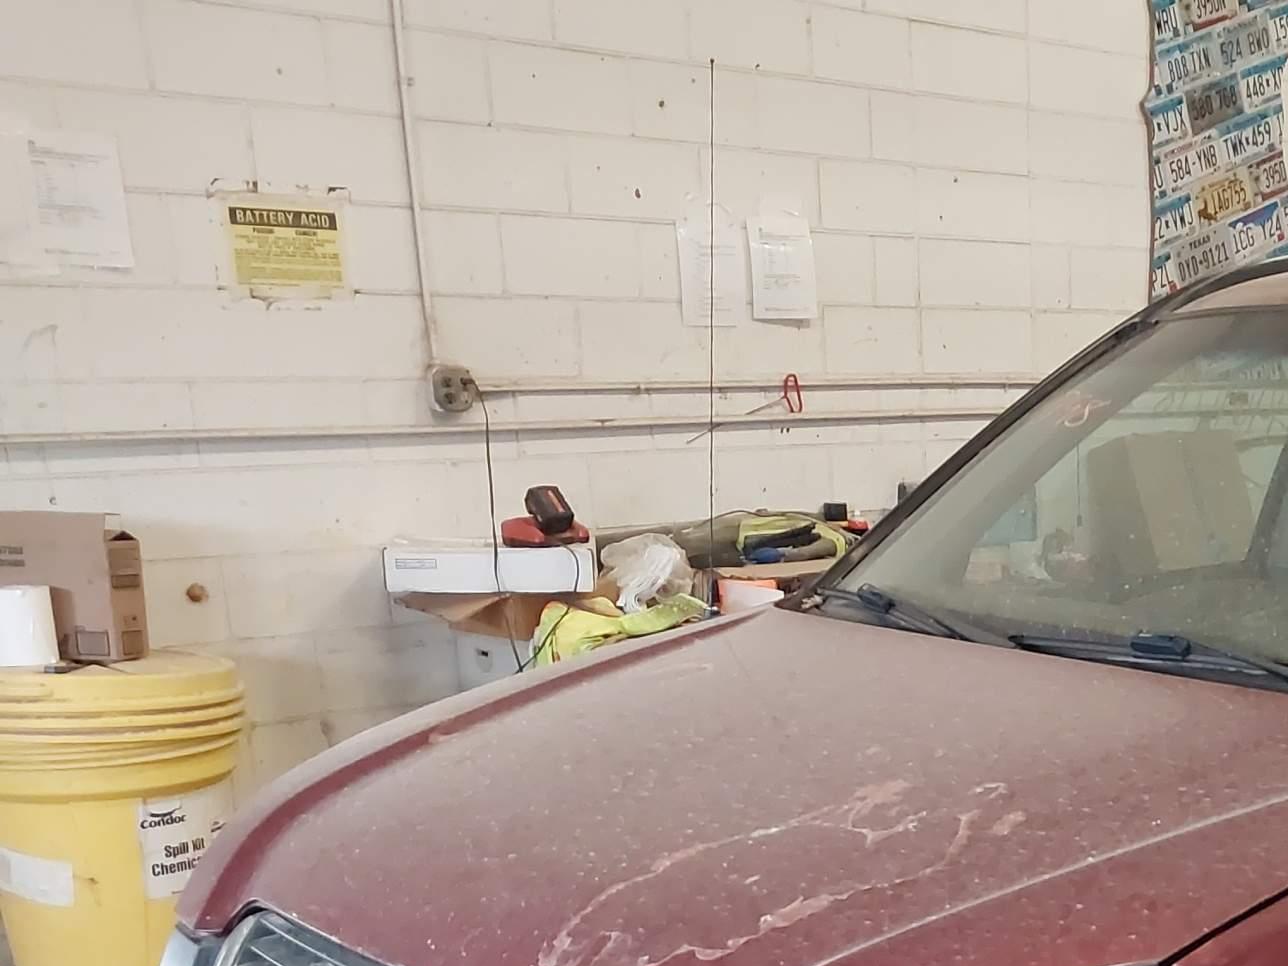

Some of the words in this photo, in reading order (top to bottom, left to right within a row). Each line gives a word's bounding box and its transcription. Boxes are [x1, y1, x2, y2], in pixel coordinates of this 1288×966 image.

[1220, 38, 1243, 65] 524
[235, 209, 294, 225] BATTERY
[301, 212, 330, 228] ACID
[1189, 234, 1211, 251] TEXAS
[140, 813, 187, 830] Condor
[164, 842, 190, 859] Spill
[192, 837, 206, 852] Kit
[152, 855, 201, 877] Chemic
